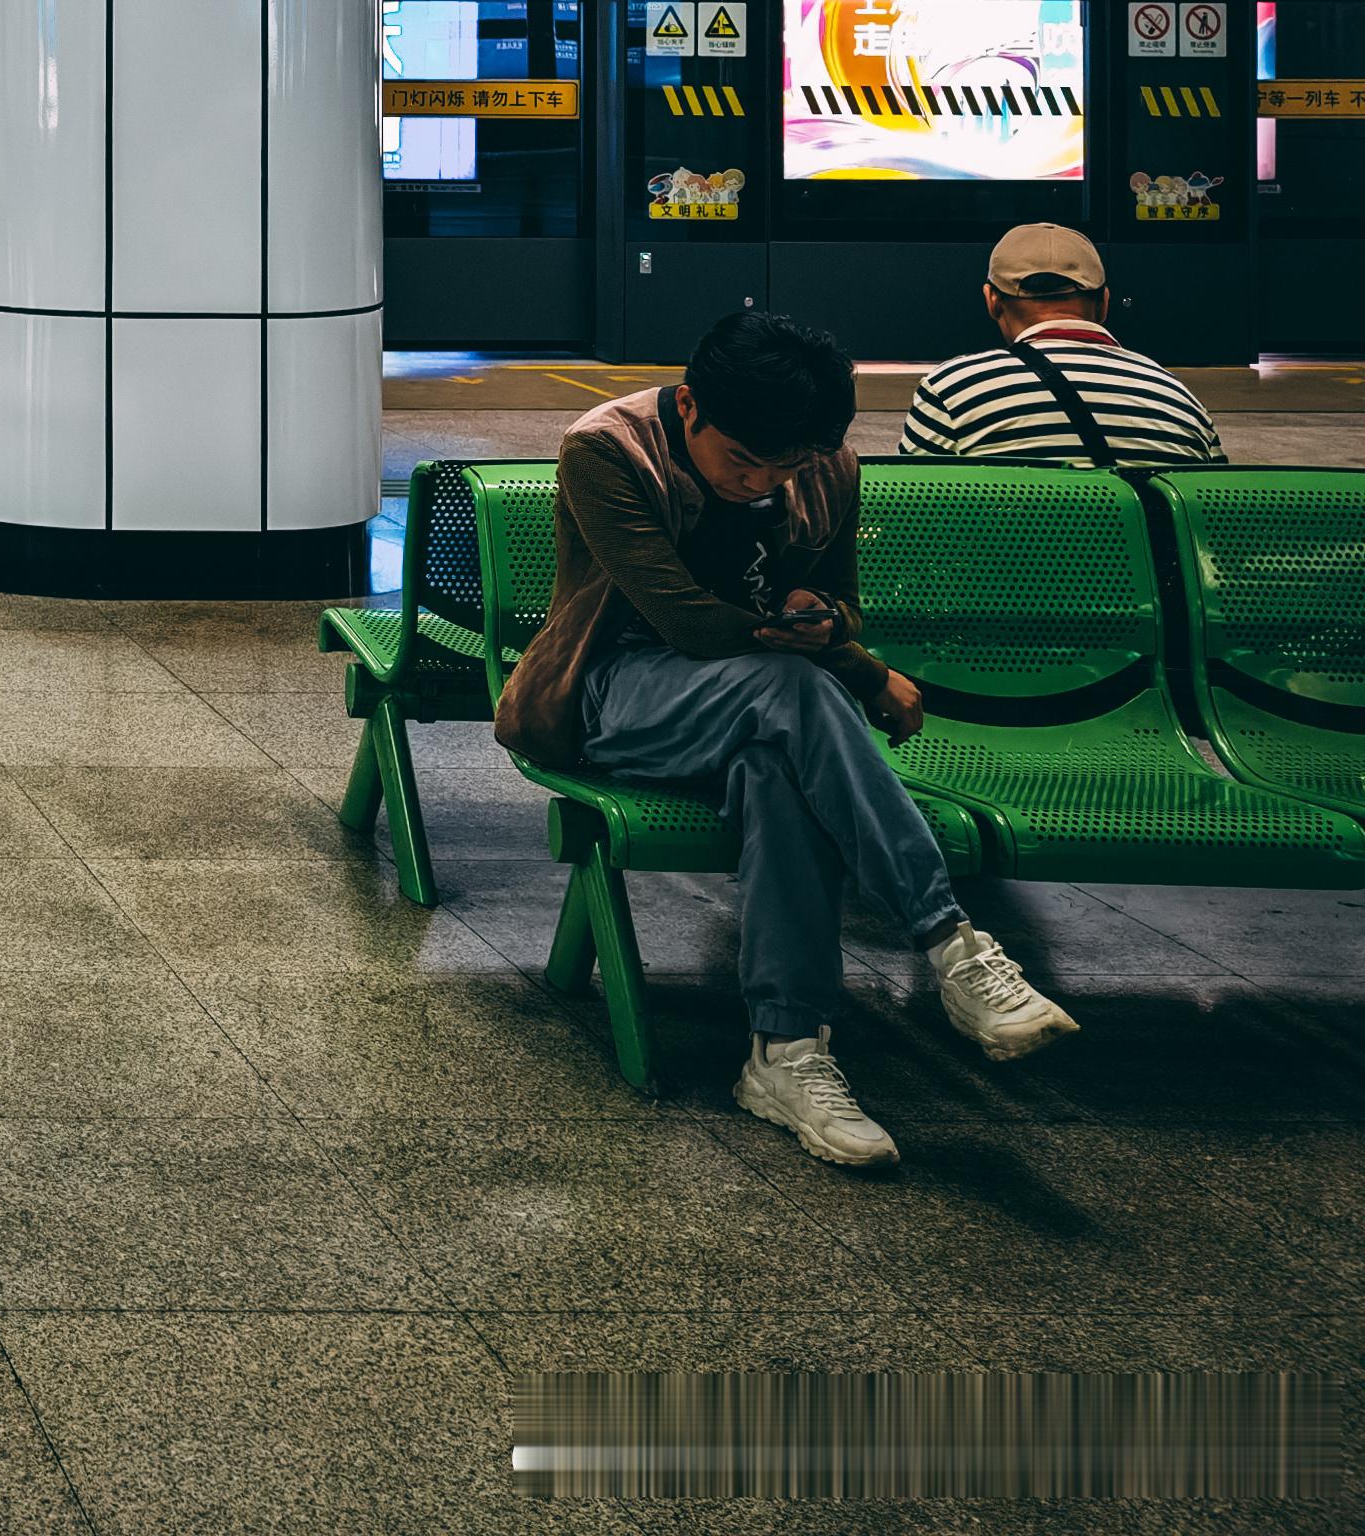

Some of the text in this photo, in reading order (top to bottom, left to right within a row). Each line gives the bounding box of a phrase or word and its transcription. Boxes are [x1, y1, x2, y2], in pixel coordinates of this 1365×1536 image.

[392, 90, 563, 108] 门灯闪烁 请勿上下车
[661, 205, 726, 217] 文明礼让
